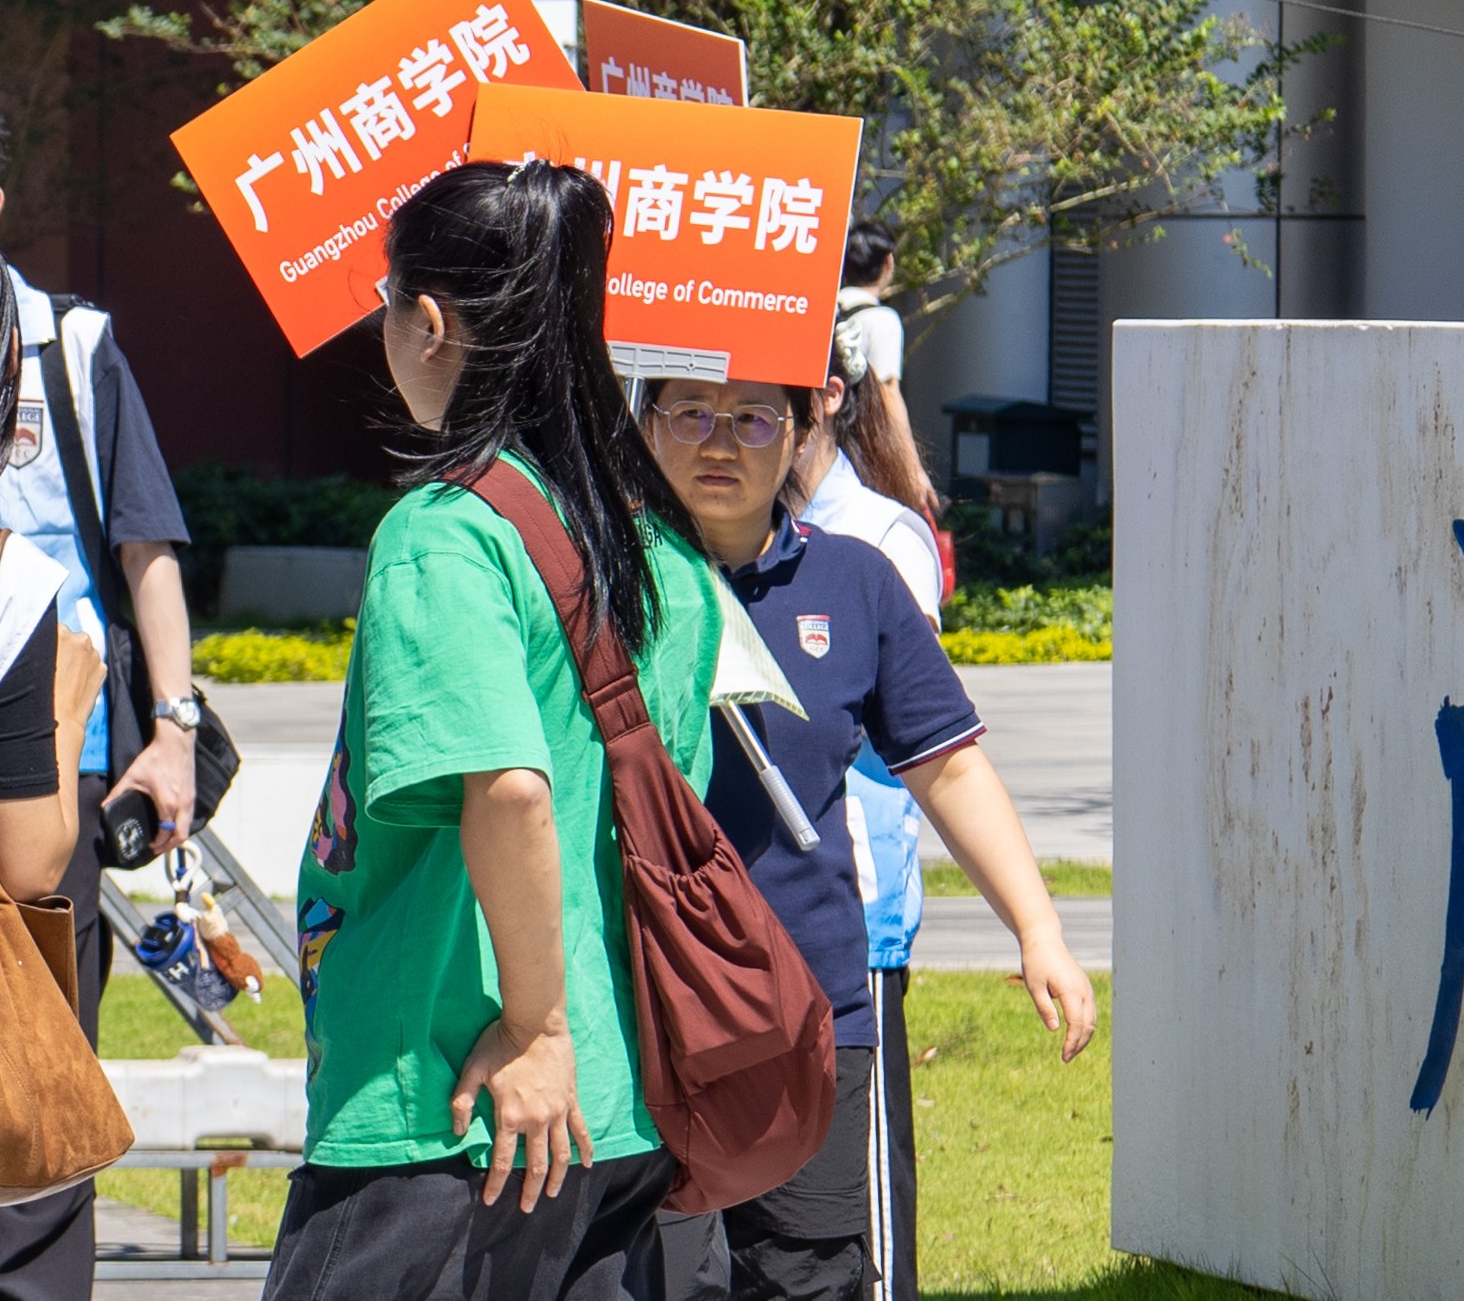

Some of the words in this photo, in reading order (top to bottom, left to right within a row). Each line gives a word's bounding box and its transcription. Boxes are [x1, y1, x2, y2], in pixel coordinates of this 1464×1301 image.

[234, 3, 530, 233] 广州商学院
[503, 151, 824, 255] 商学院
[278, 213, 378, 283] Guangzhou
[606, 272, 668, 305] ollege
[673, 279, 695, 303] of
[697, 282, 809, 315] Commerce
